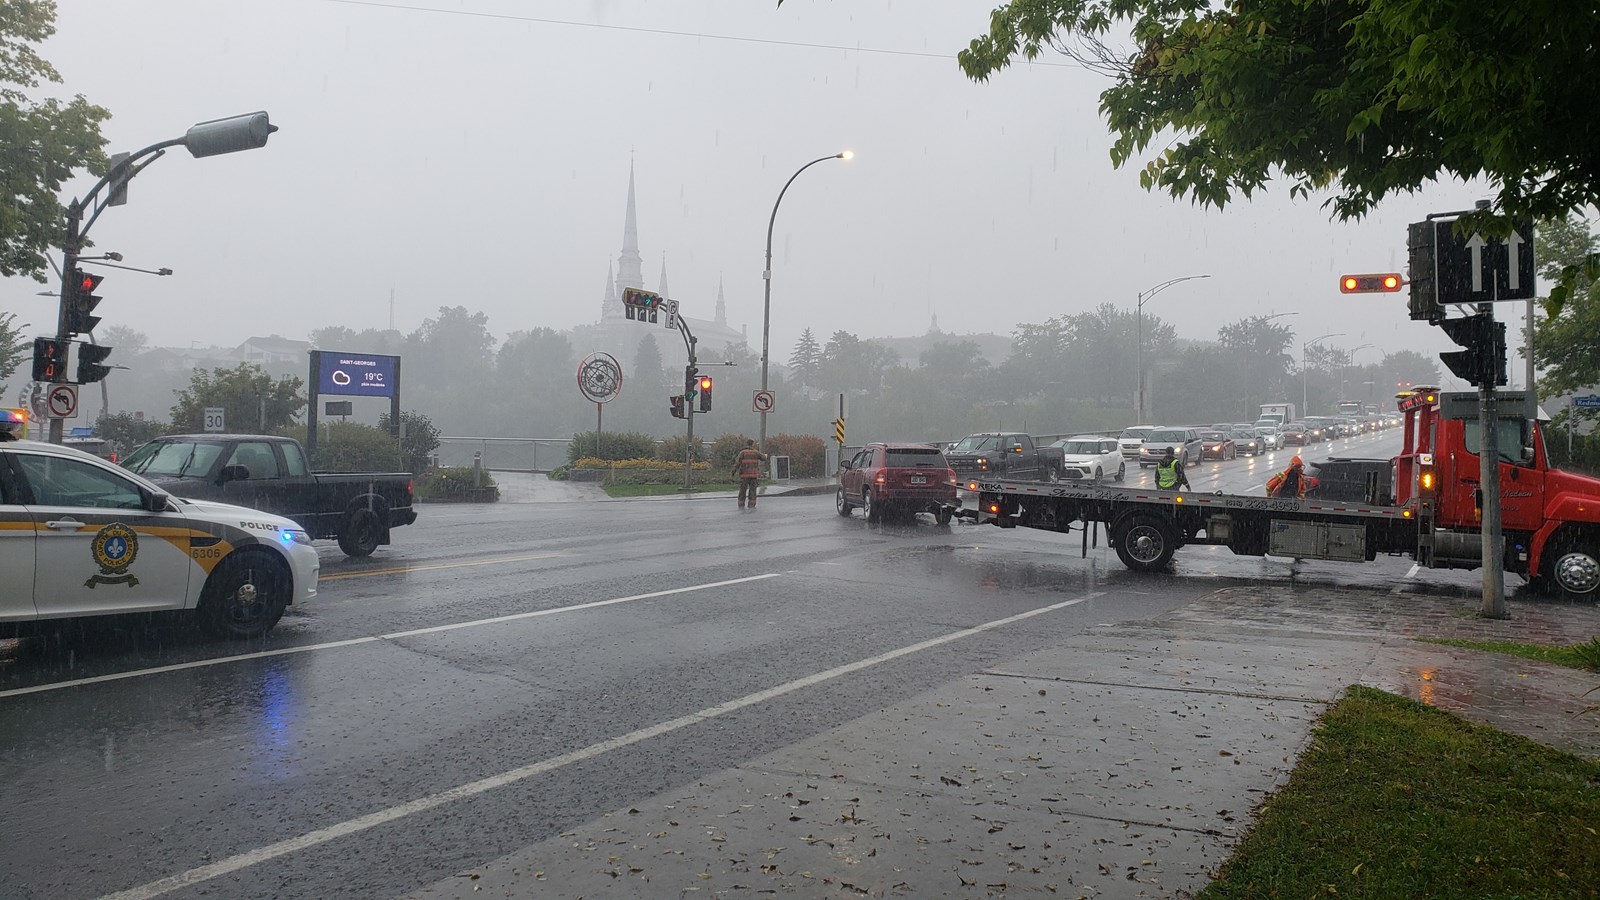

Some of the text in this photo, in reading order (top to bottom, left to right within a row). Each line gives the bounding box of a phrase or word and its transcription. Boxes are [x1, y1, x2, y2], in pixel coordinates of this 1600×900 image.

[340, 359, 376, 367] SAINT-GEORGES
[364, 372, 383, 381] 19°C
[206, 415, 222, 428] 30
[240, 521, 280, 532] POLICE
[192, 549, 220, 559] 6306
